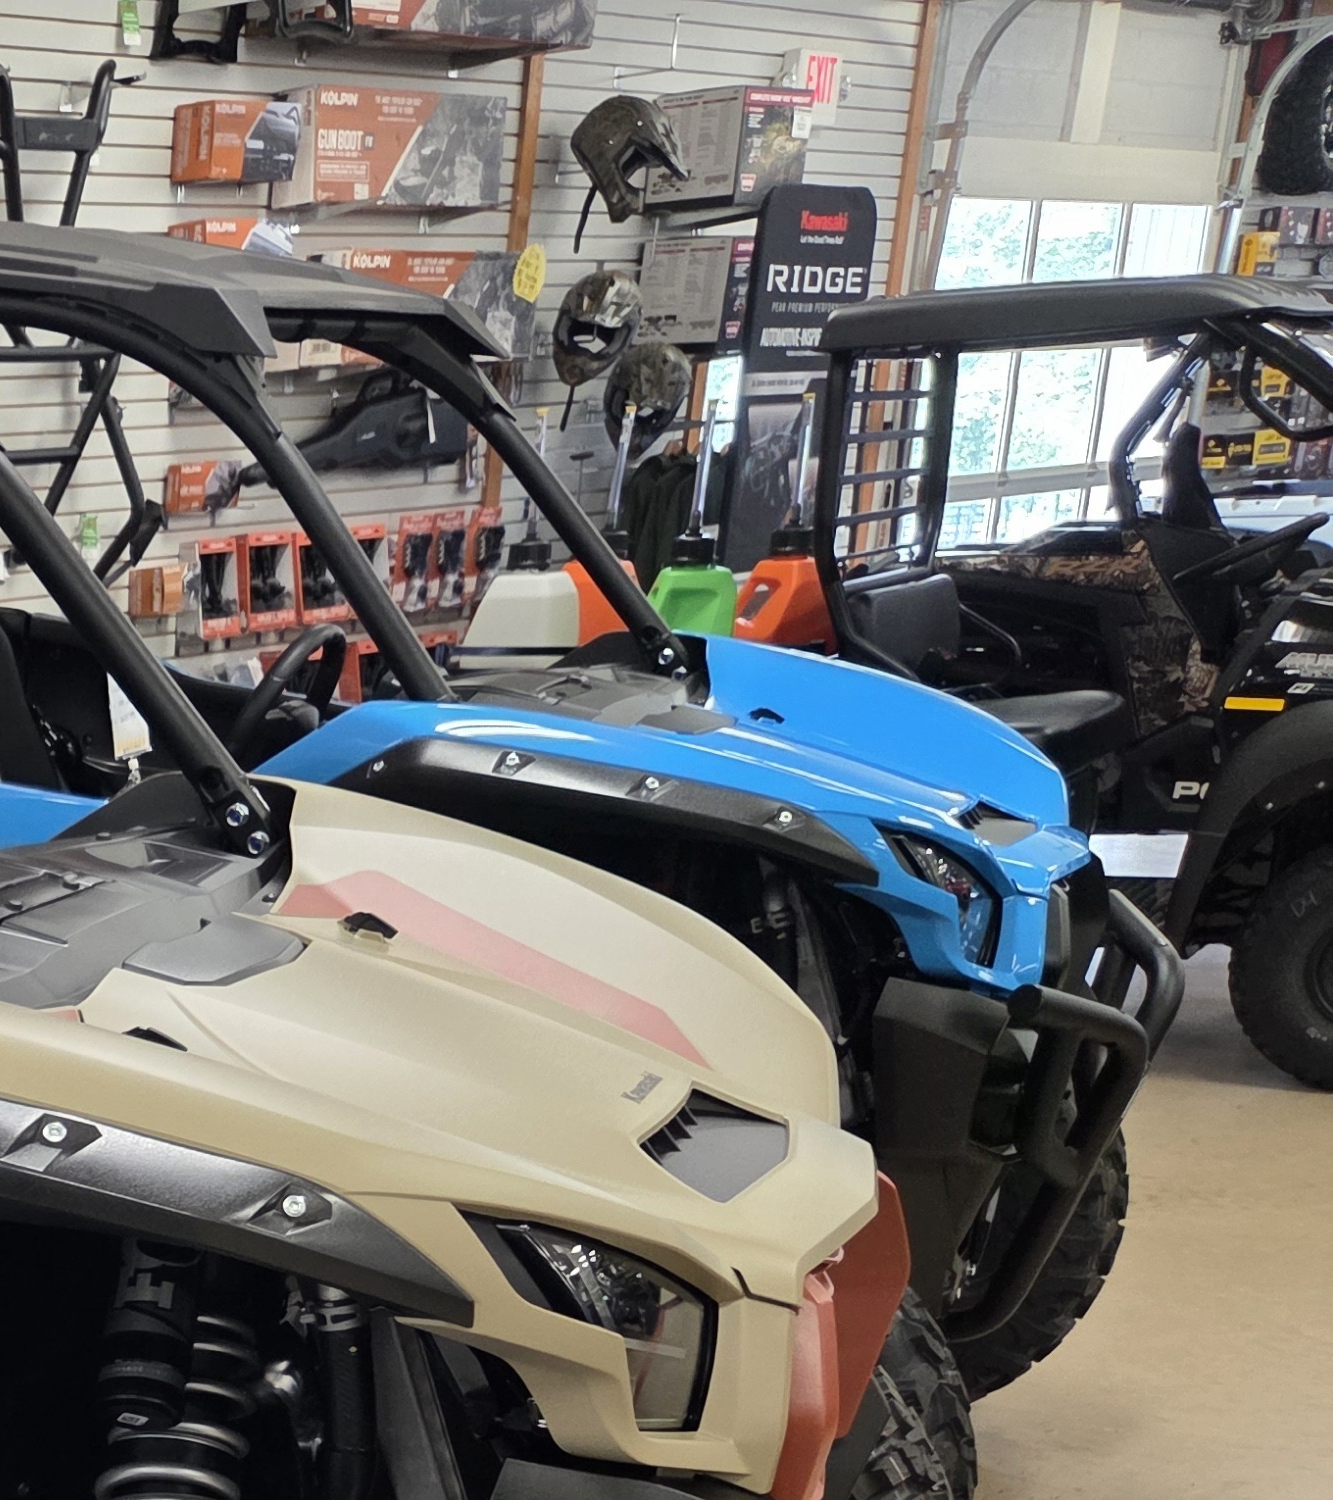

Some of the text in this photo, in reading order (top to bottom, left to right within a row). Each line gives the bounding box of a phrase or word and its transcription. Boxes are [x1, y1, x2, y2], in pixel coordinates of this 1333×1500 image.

[806, 56, 837, 104] EXIT
[800, 210, 848, 231] Kawasaki
[766, 263, 864, 294] RIDGE
